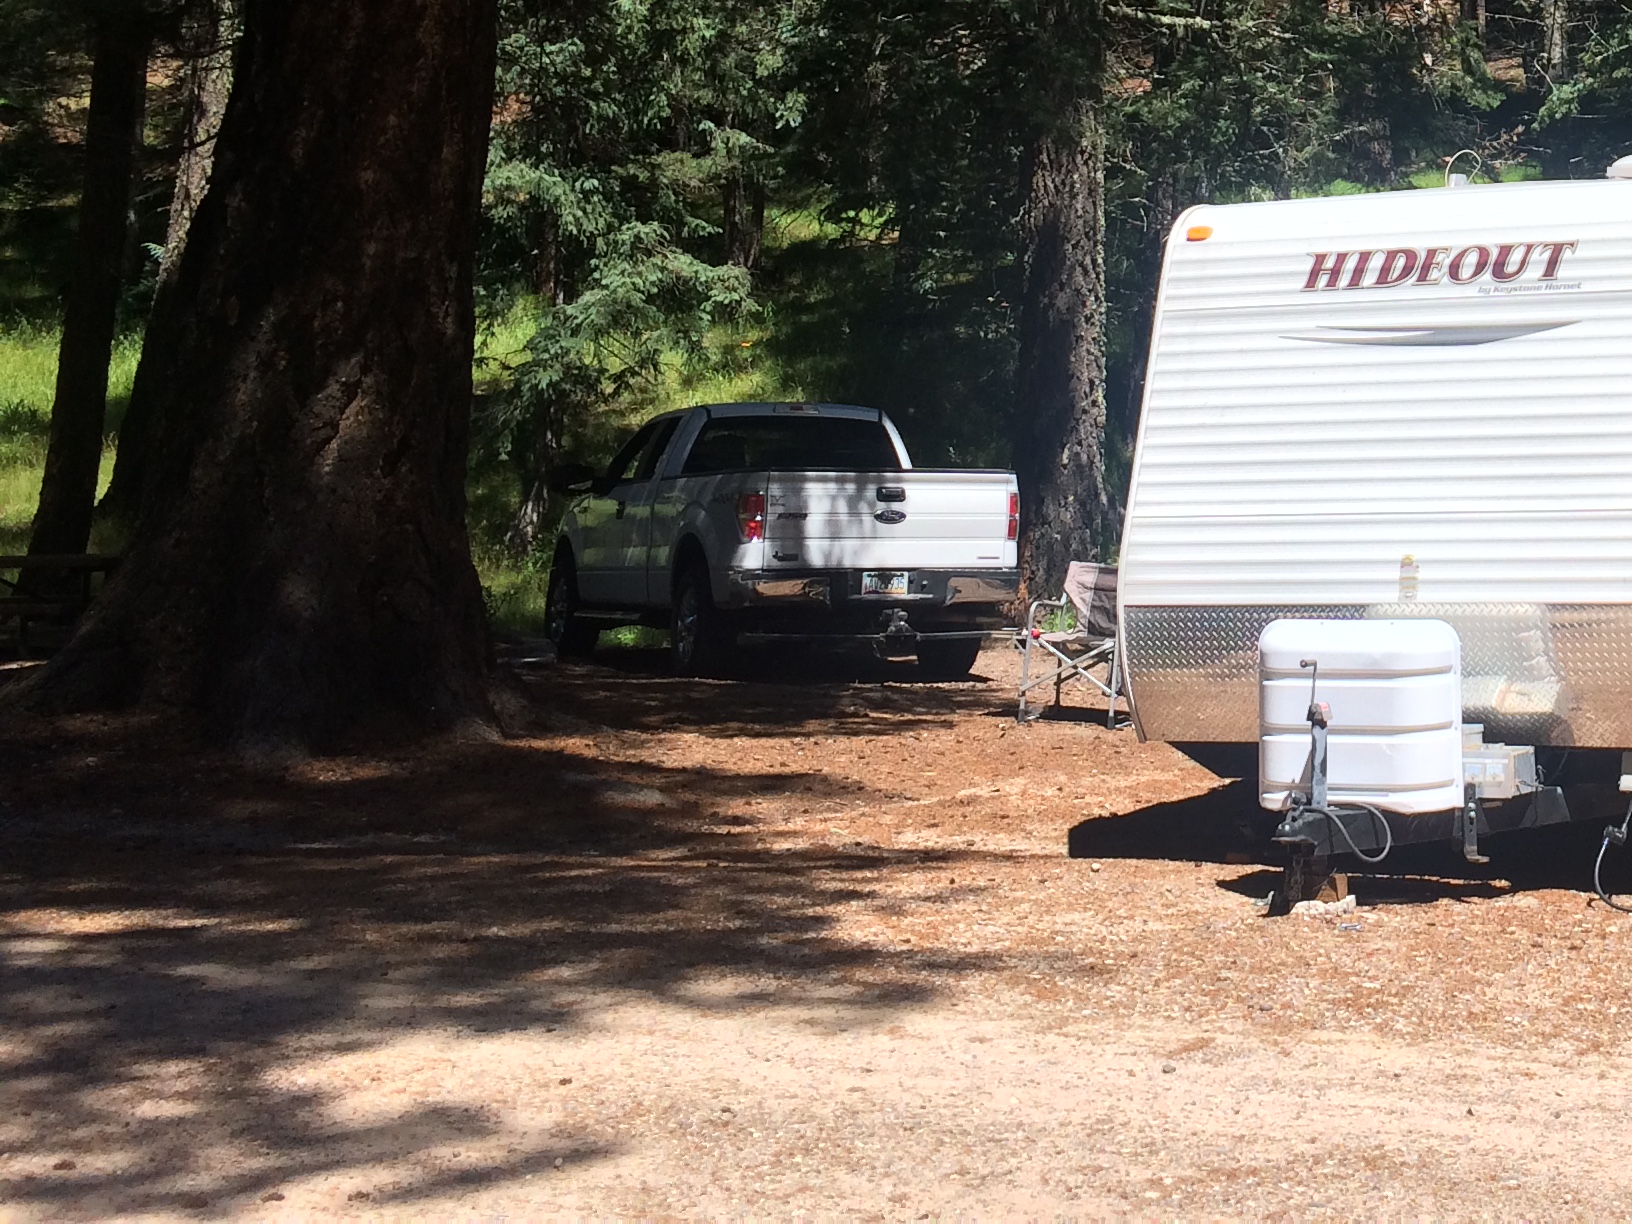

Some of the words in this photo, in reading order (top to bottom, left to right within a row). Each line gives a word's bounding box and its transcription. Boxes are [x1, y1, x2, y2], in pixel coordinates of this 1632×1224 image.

[1300, 239, 1579, 292] HIDEOUT
[1477, 286, 1491, 294] by
[1493, 283, 1543, 294] Keystone
[1544, 281, 1582, 291] Hornet
